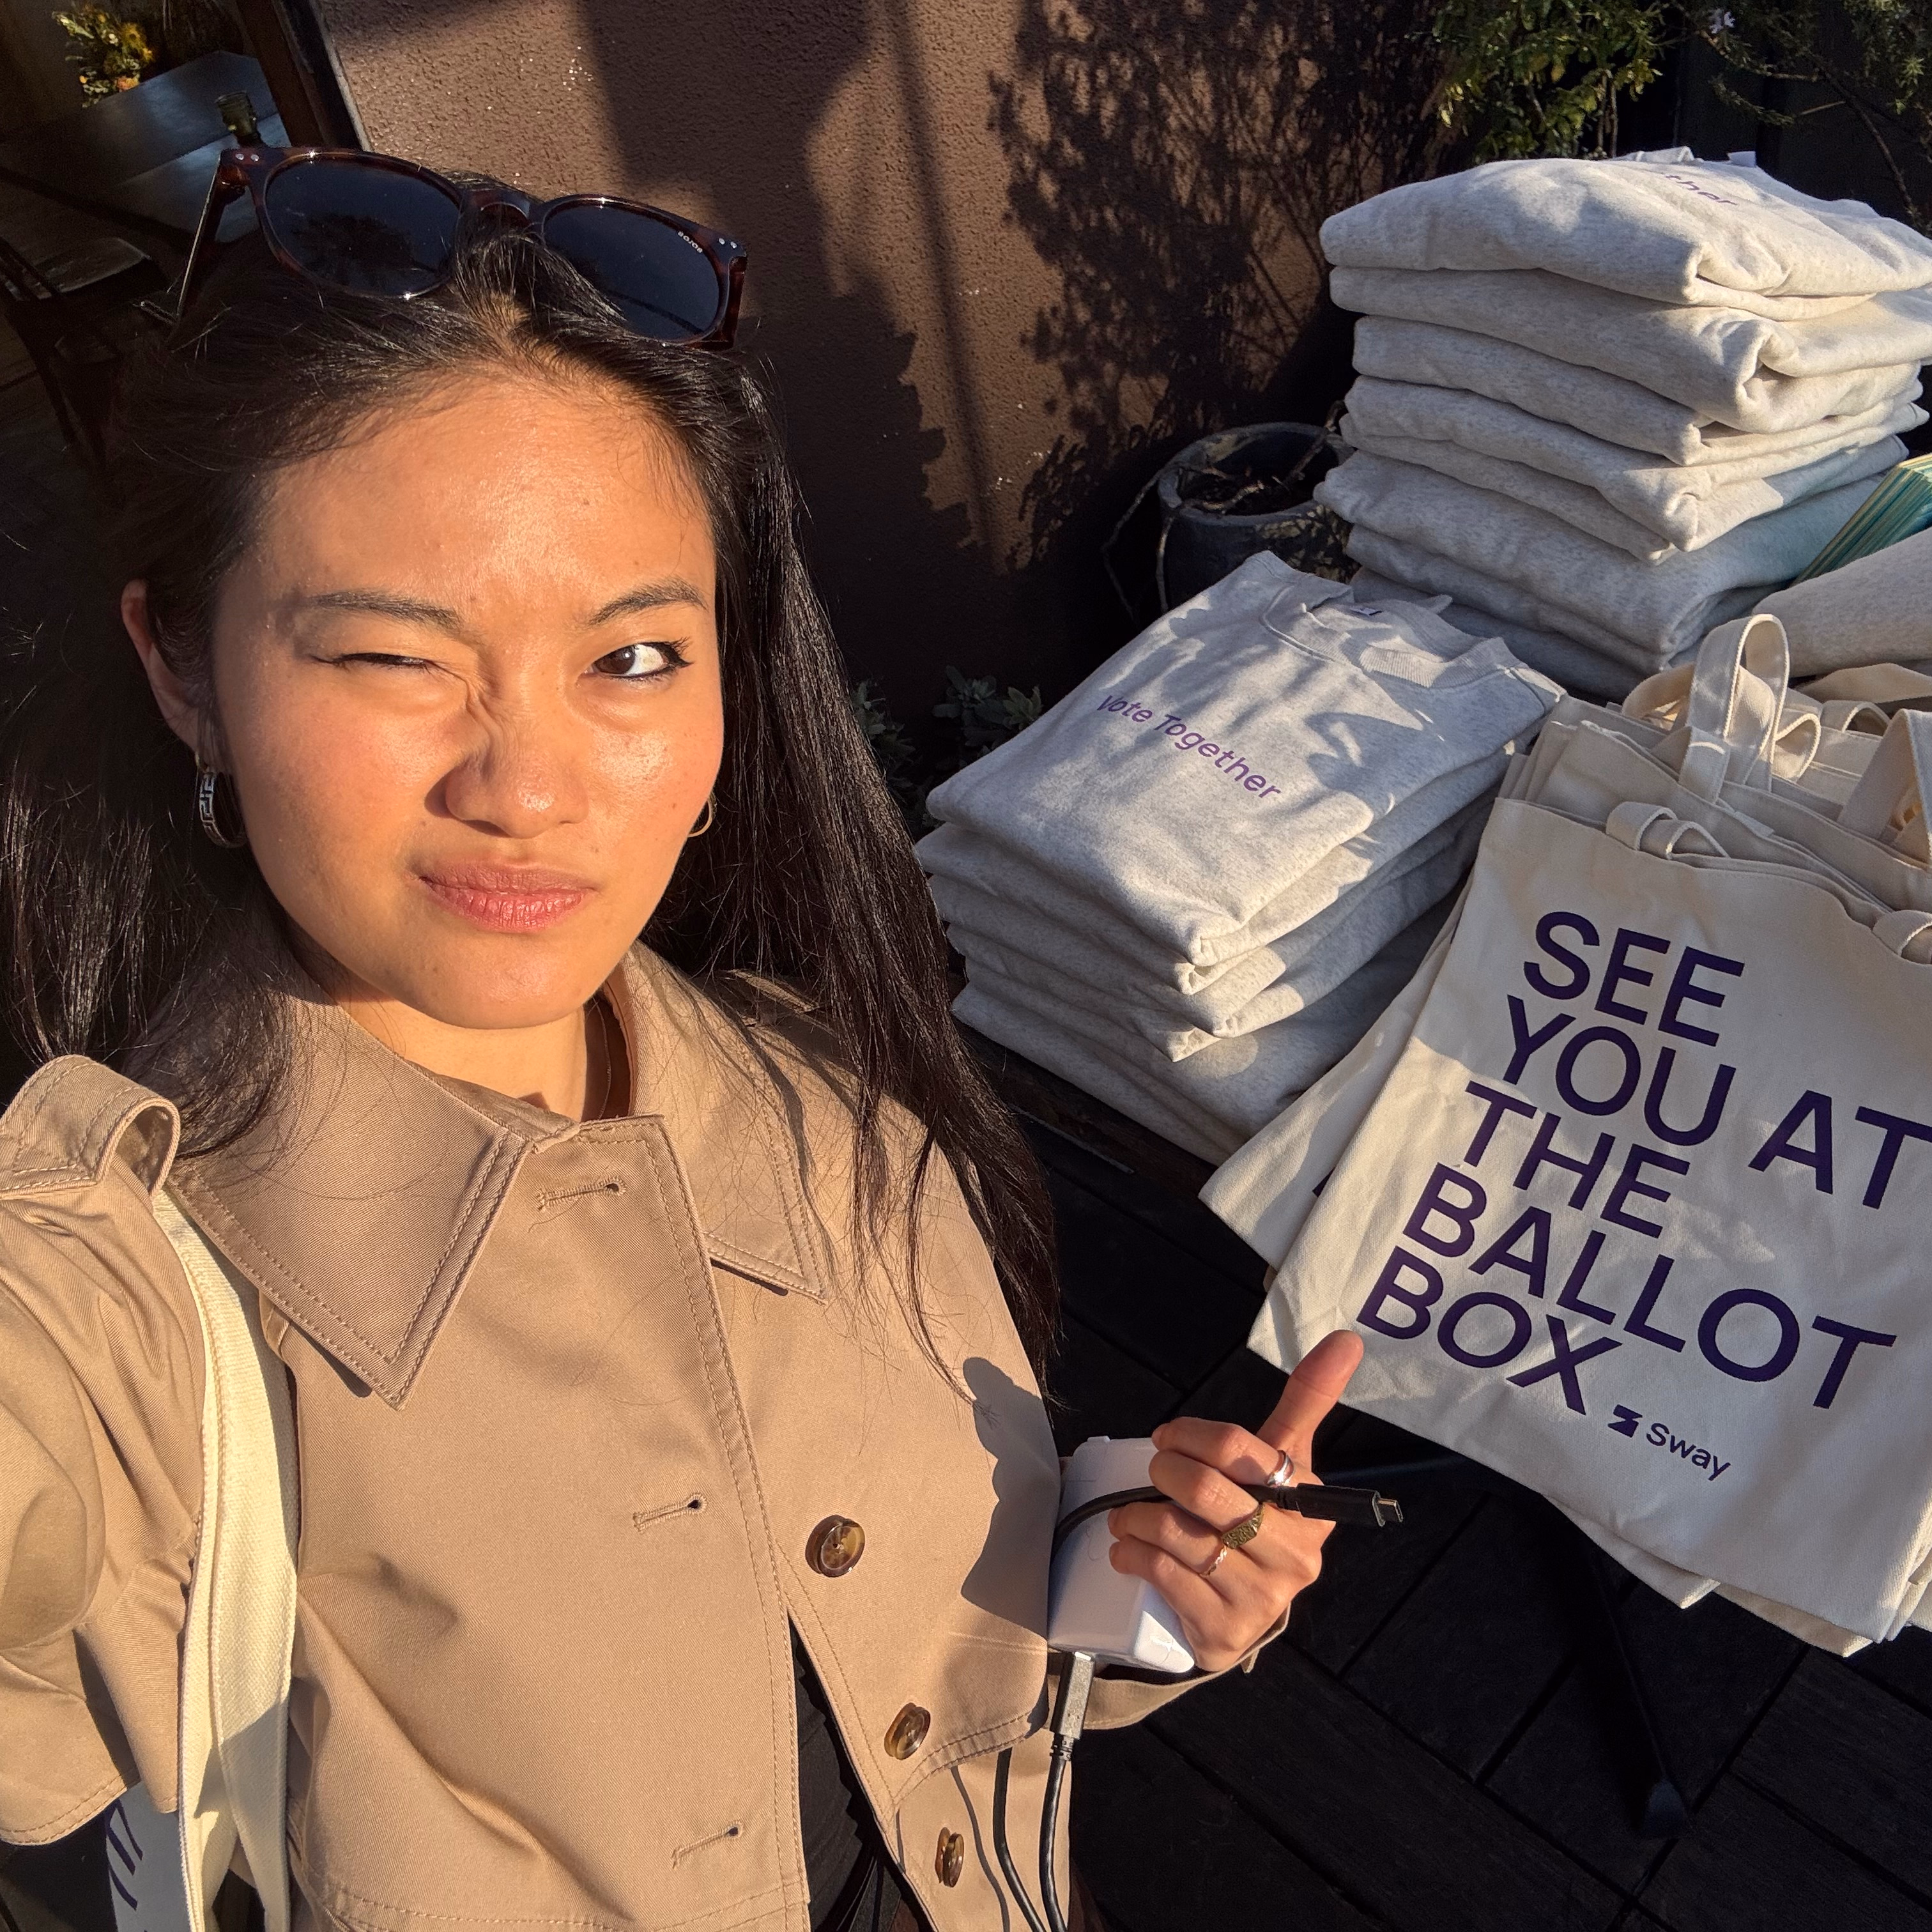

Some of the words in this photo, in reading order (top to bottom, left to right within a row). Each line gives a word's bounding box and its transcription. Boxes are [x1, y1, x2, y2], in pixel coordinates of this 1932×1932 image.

[1096, 694, 1153, 723] Vote
[1153, 714, 1282, 799] Together
[1523, 910, 1745, 1047] SEE
[1465, 1080, 1691, 1239] THE
[1502, 994, 1737, 1146] YOU
[1747, 1089, 1932, 1210] AT
[1355, 1245, 1623, 1416] BOX
[1402, 1161, 1897, 1410] BALLOT
[1645, 1422, 1732, 1482] Sway
